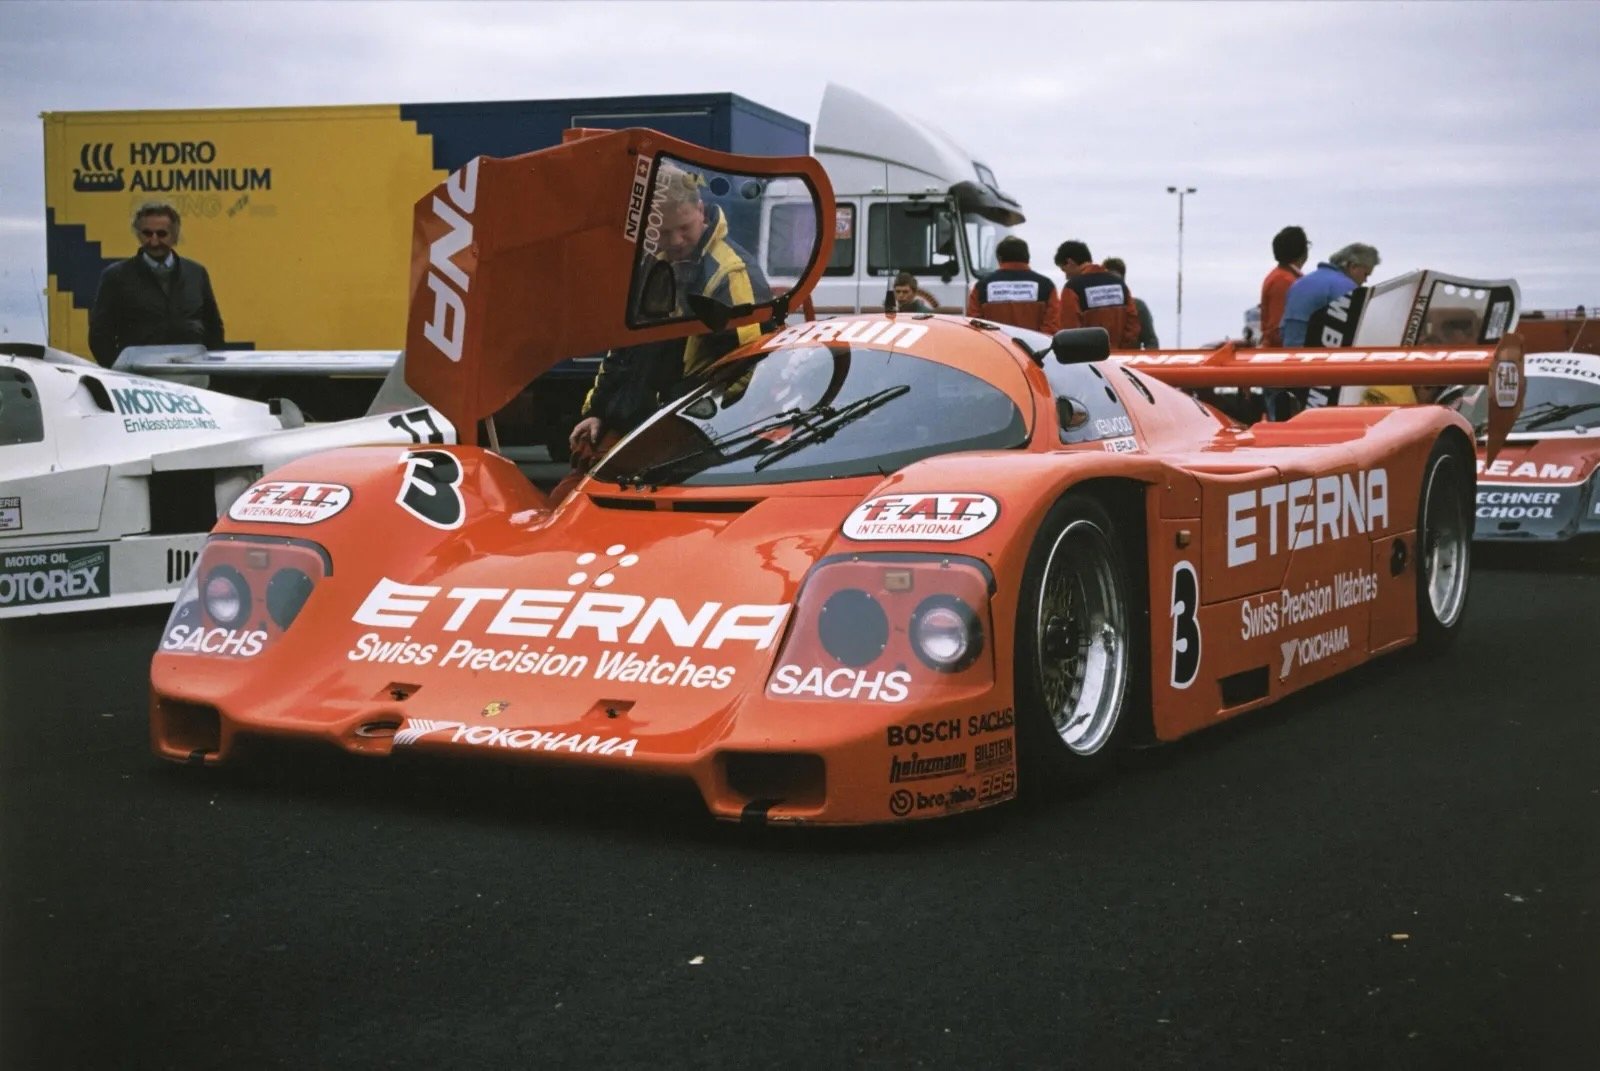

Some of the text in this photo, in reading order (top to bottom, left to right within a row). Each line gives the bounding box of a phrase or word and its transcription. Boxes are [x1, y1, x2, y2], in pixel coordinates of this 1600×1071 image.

[130, 141, 216, 164] HYDRO
[129, 168, 271, 191] ALUMINIUM
[626, 182, 645, 239] BRUN
[643, 172, 672, 257] ENWOOD
[760, 320, 929, 349] BRUN
[1247, 350, 1490, 364] ETERNA
[1527, 358, 1581, 367] HNER
[111, 388, 211, 415] MOTOREX
[388, 408, 444, 444] 17
[1115, 440, 1137, 452] BRUN
[395, 449, 466, 530] 3
[1476, 492, 1561, 504] ECHNER
[238, 507, 317, 520] INTERNATIONAL
[856, 523, 966, 535] INTERNATIONAL
[1227, 468, 1389, 568] ETERNA
[1476, 506, 1553, 519] CHOOL
[5, 554, 47, 568] MOTOR
[50, 553, 69, 564] OIL
[0, 566, 101, 604] OTOREX
[351, 576, 791, 651] ETERNA
[1241, 568, 1377, 640] Swiss Precision Watches
[164, 624, 268, 657] SACHS
[1170, 560, 1201, 690] 3
[347, 633, 736, 690] Swiss Precision Watches
[1296, 625, 1350, 666] YOKOHAMA
[770, 665, 912, 702] SACHS
[450, 724, 639, 757] YOKOHAMA
[887, 706, 1015, 747] BOSCH SACHS
[974, 736, 1013, 762] BILSTEIN
